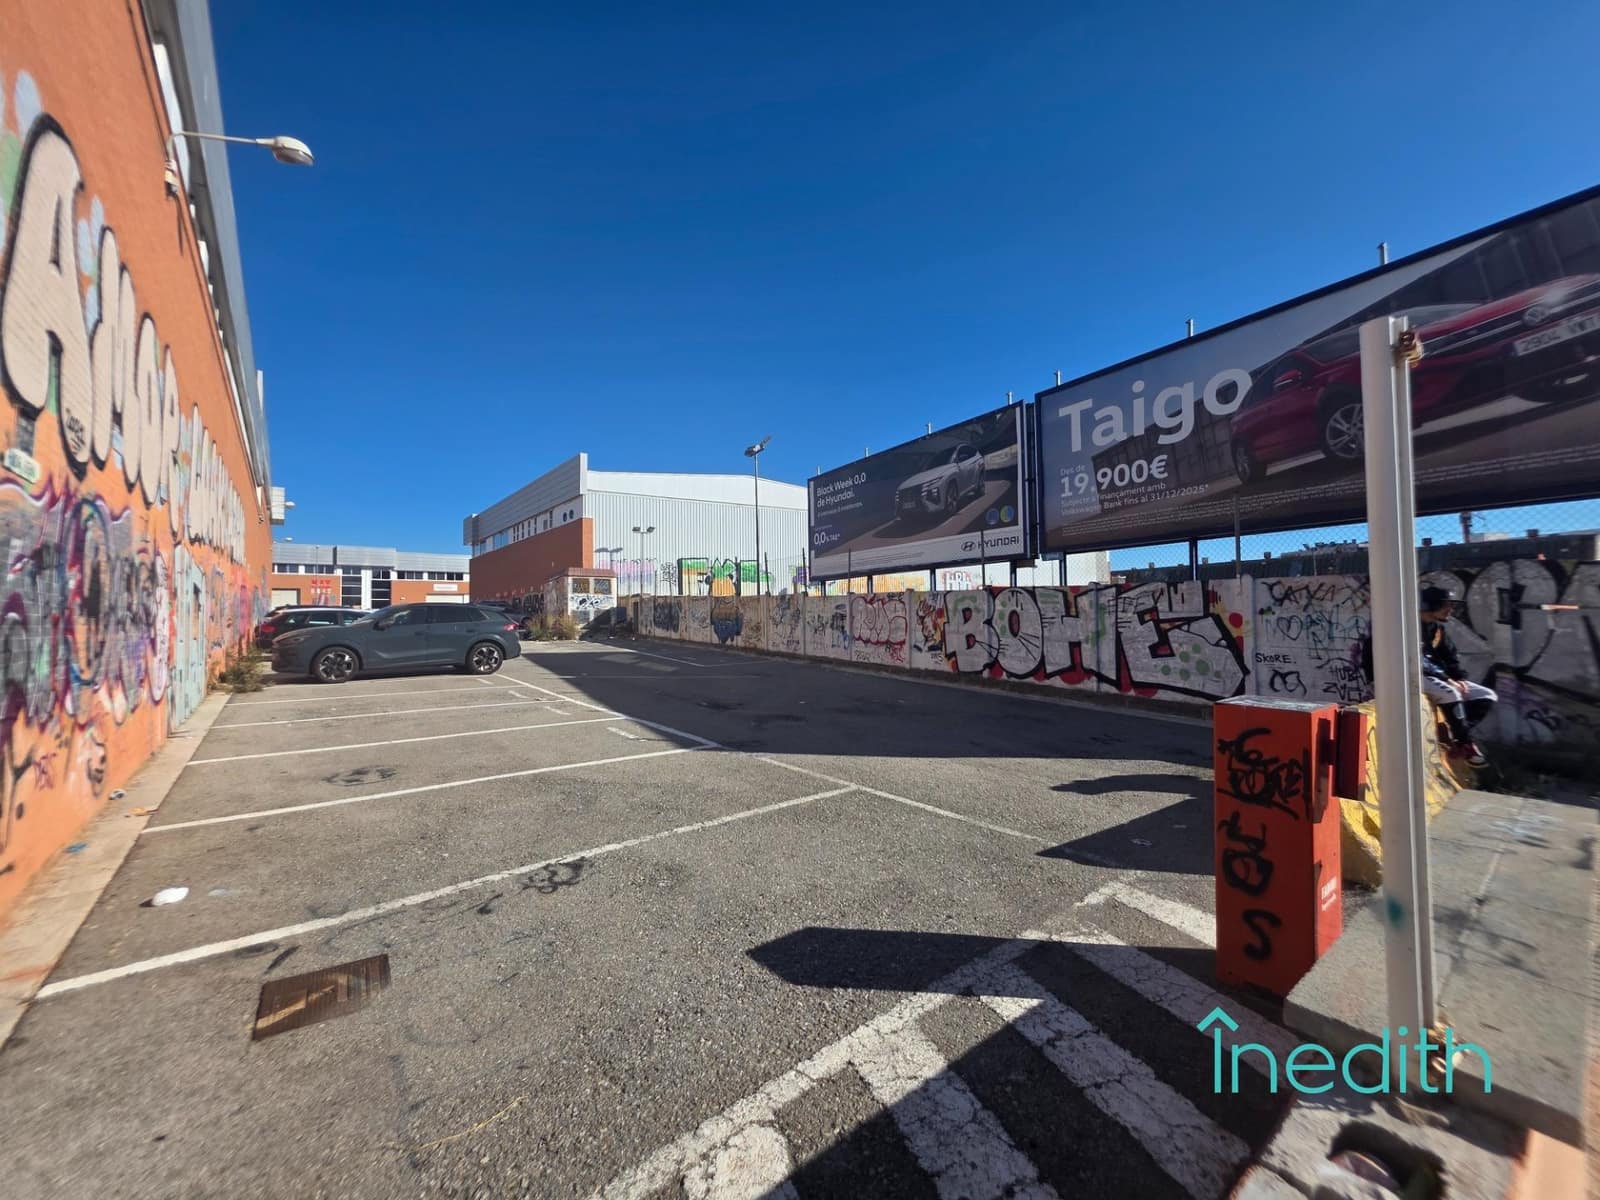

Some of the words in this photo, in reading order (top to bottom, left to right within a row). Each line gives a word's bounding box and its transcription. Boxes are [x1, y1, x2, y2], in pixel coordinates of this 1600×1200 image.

[1058, 368, 1253, 453] Taigo
[834, 477, 854, 490] Week
[853, 472, 867, 485] 0,0
[1060, 454, 1169, 498] 19.900€
[1146, 481, 1166, 492] amb
[816, 498, 825, 508] de
[1103, 499, 1123, 510] Bank
[1123, 496, 1139, 506] fins
[1139, 493, 1149, 503] al
[977, 535, 1020, 550] HYUNDAI
